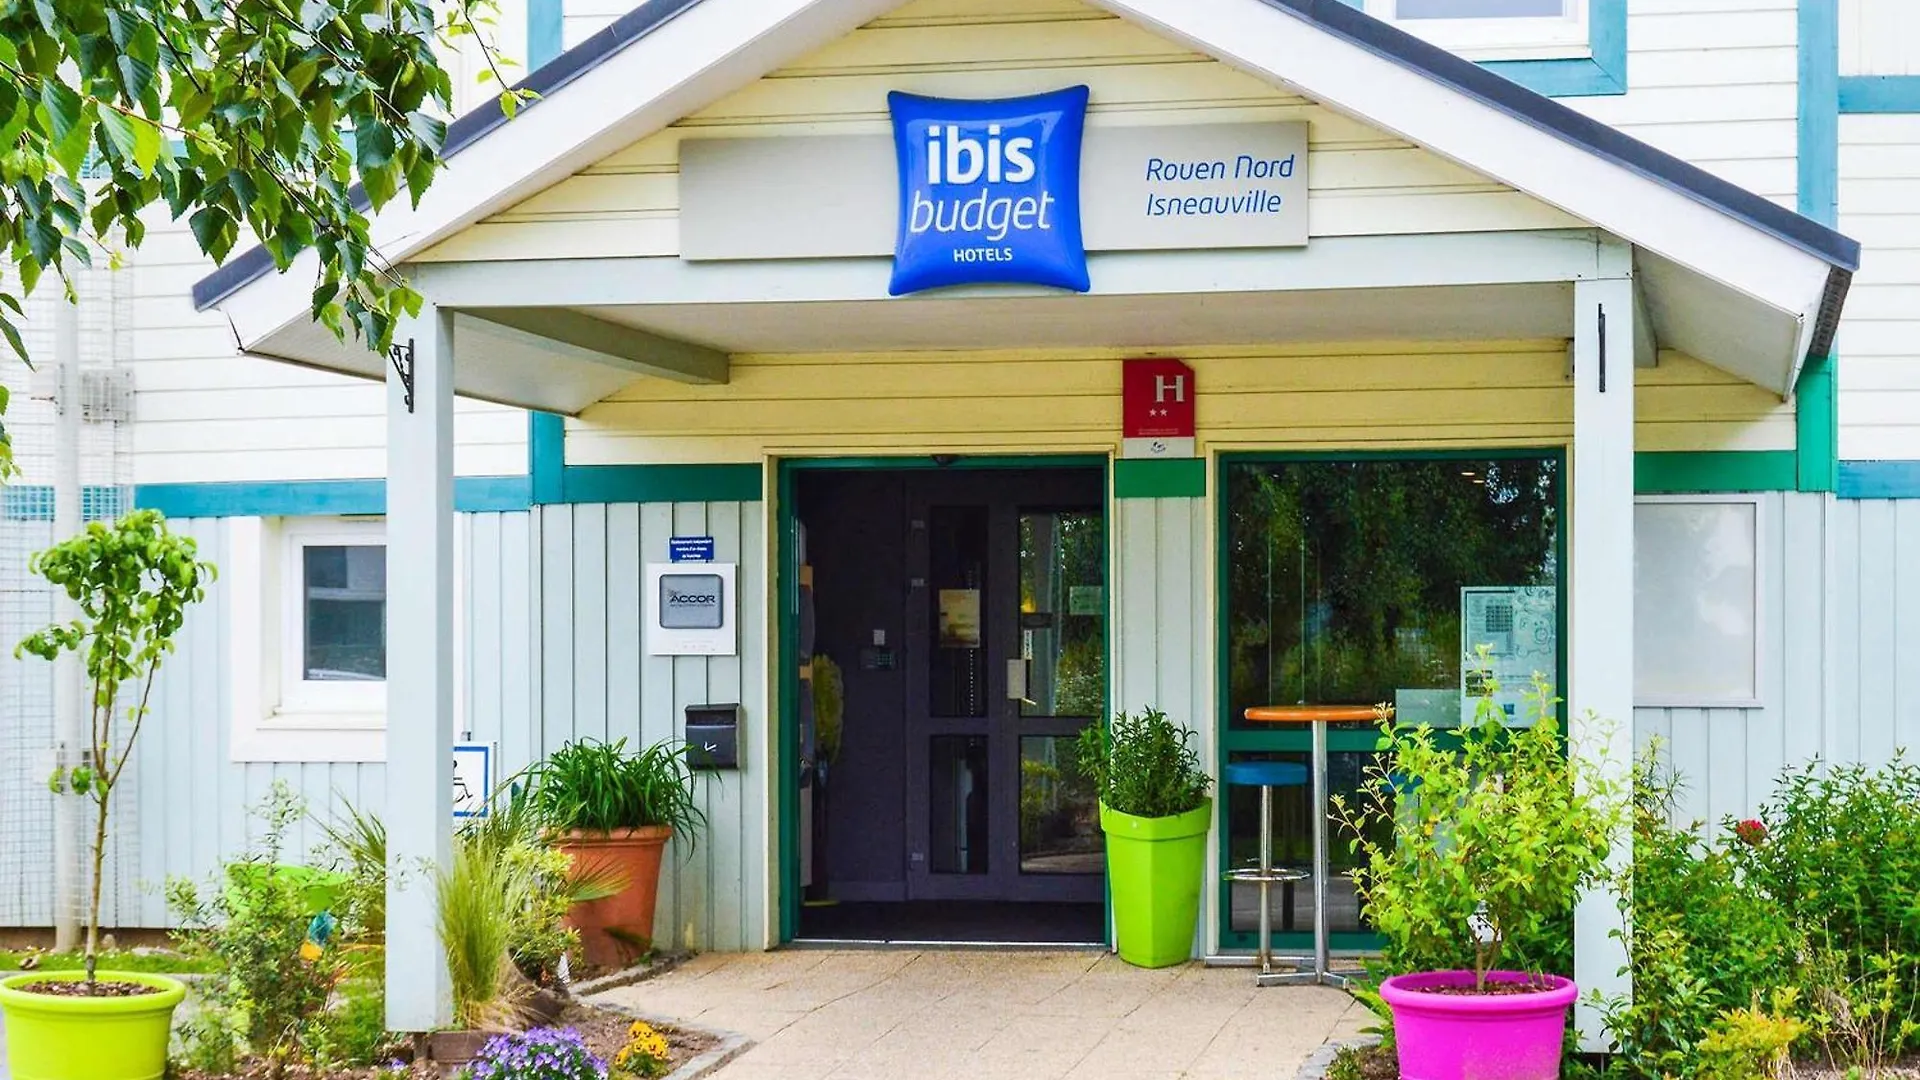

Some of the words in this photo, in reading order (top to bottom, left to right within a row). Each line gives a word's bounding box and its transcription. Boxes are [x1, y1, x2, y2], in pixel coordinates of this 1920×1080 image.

[928, 124, 1036, 185] ibis
[1146, 158, 1226, 181] Rouen
[1234, 154, 1295, 179] Nord
[910, 187, 1055, 242] budget
[1146, 189, 1282, 216] Isneauville
[953, 247, 1013, 263] HOTELS
[1155, 374, 1185, 403] H
[670, 595, 715, 603] ACCOR
